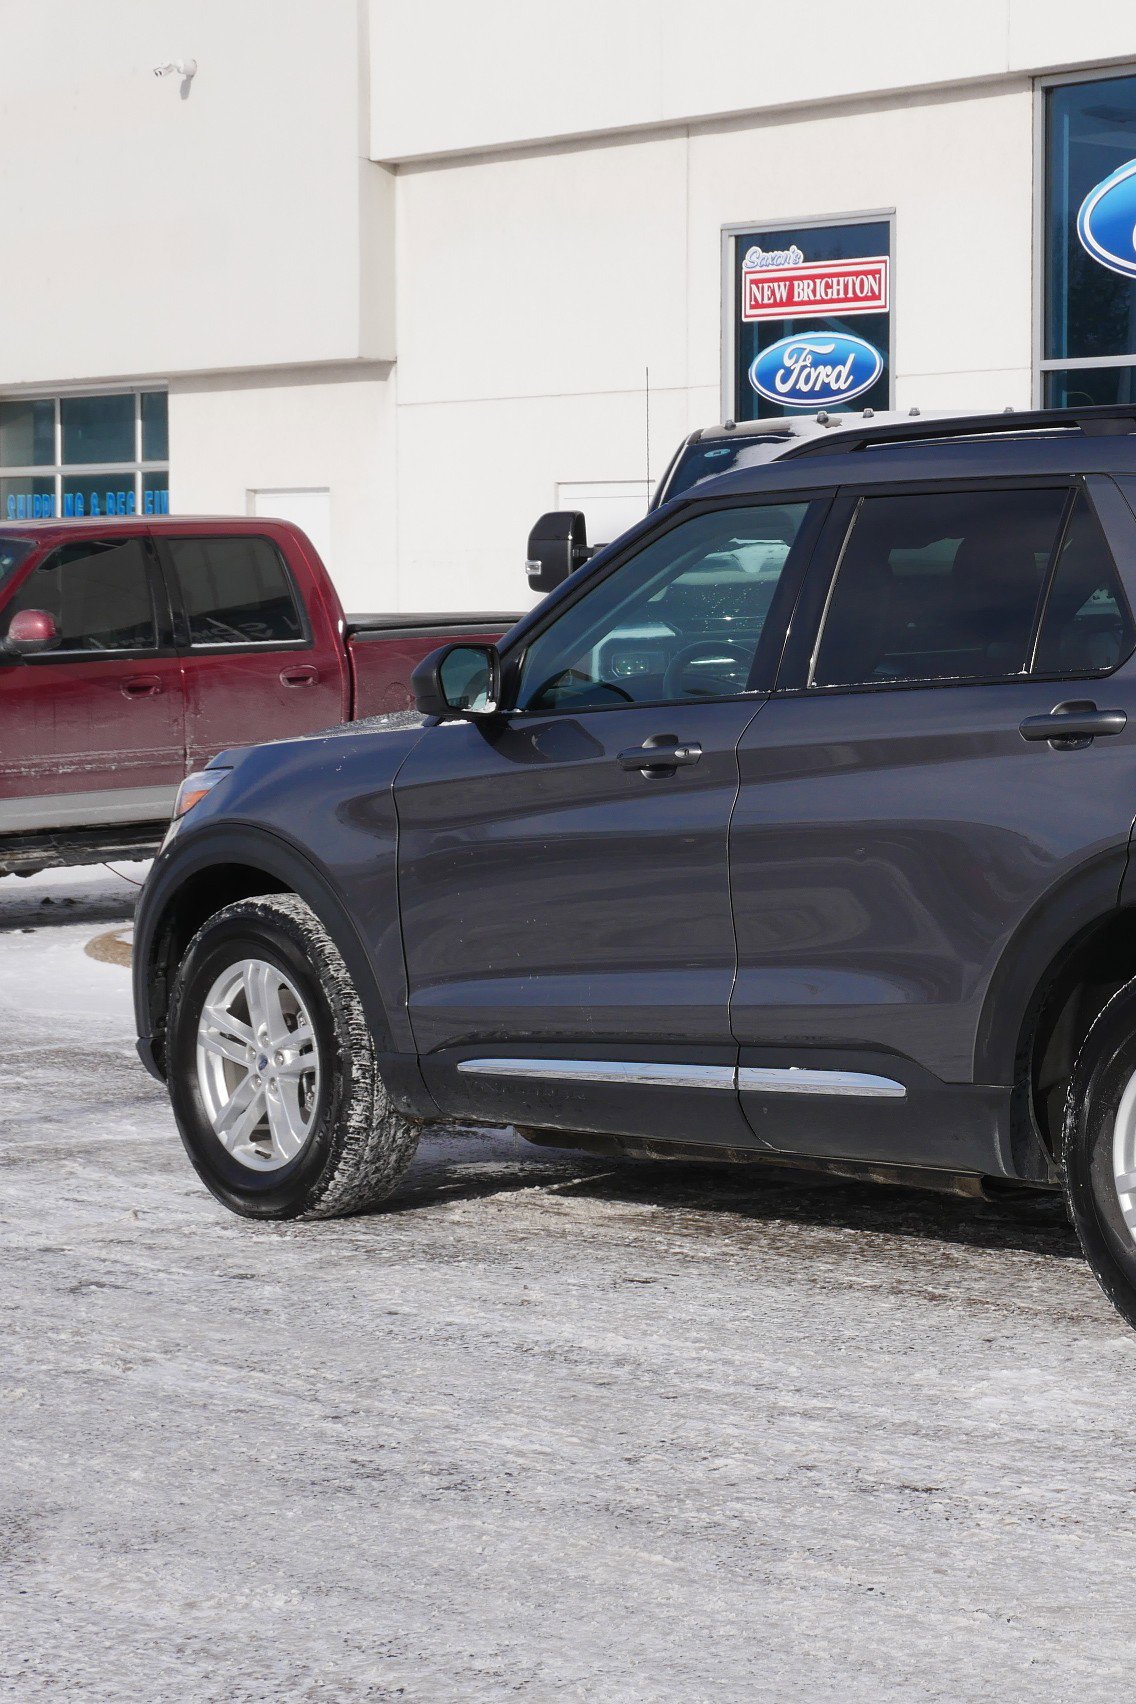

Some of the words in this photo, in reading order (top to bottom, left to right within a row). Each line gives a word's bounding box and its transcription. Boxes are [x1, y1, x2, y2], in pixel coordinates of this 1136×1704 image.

[744, 249, 801, 269] Saxon's
[750, 282, 790, 305] NEW
[793, 274, 880, 302] BRIGHTON
[774, 343, 855, 393] Ford
